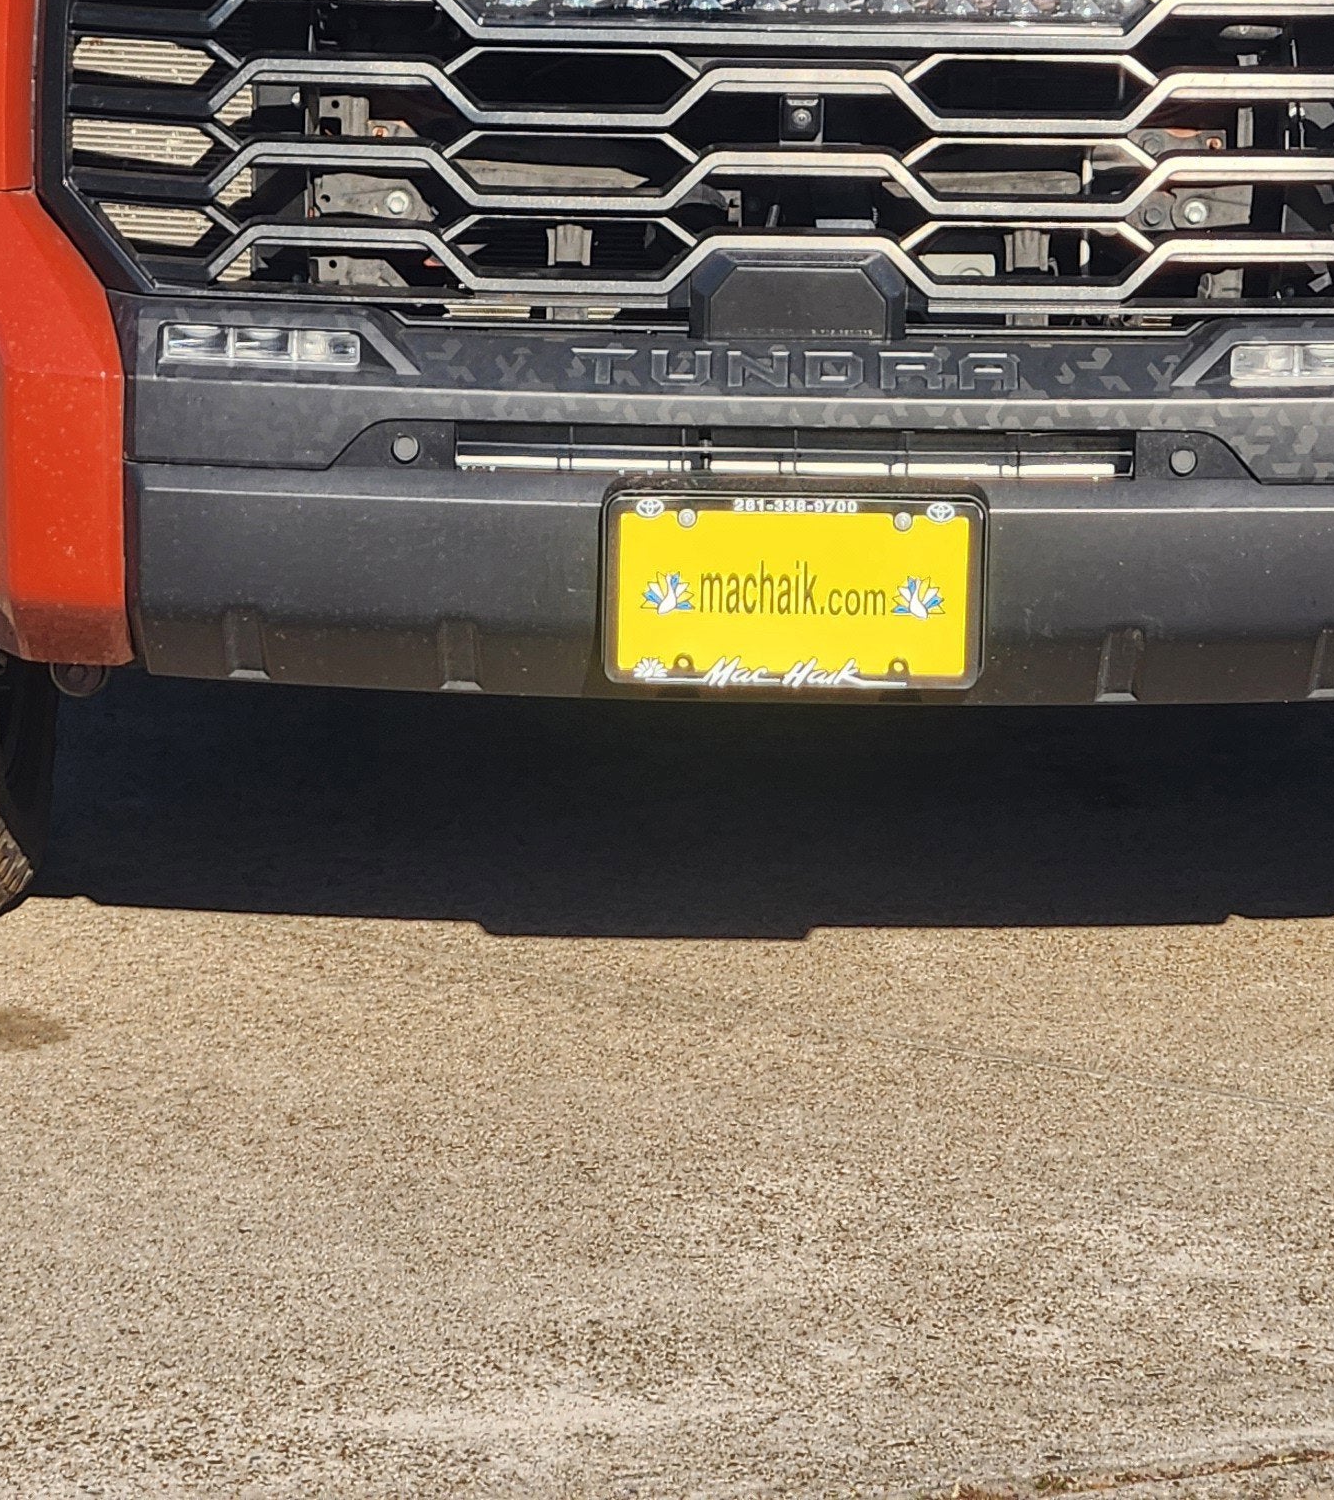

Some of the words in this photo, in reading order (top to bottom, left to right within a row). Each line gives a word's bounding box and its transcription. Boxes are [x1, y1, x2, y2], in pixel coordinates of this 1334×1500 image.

[570, 346, 1022, 391] TUNDRA
[699, 560, 886, 617] machaik.com
[700, 655, 780, 688] Mac
[782, 657, 862, 689] Haik
